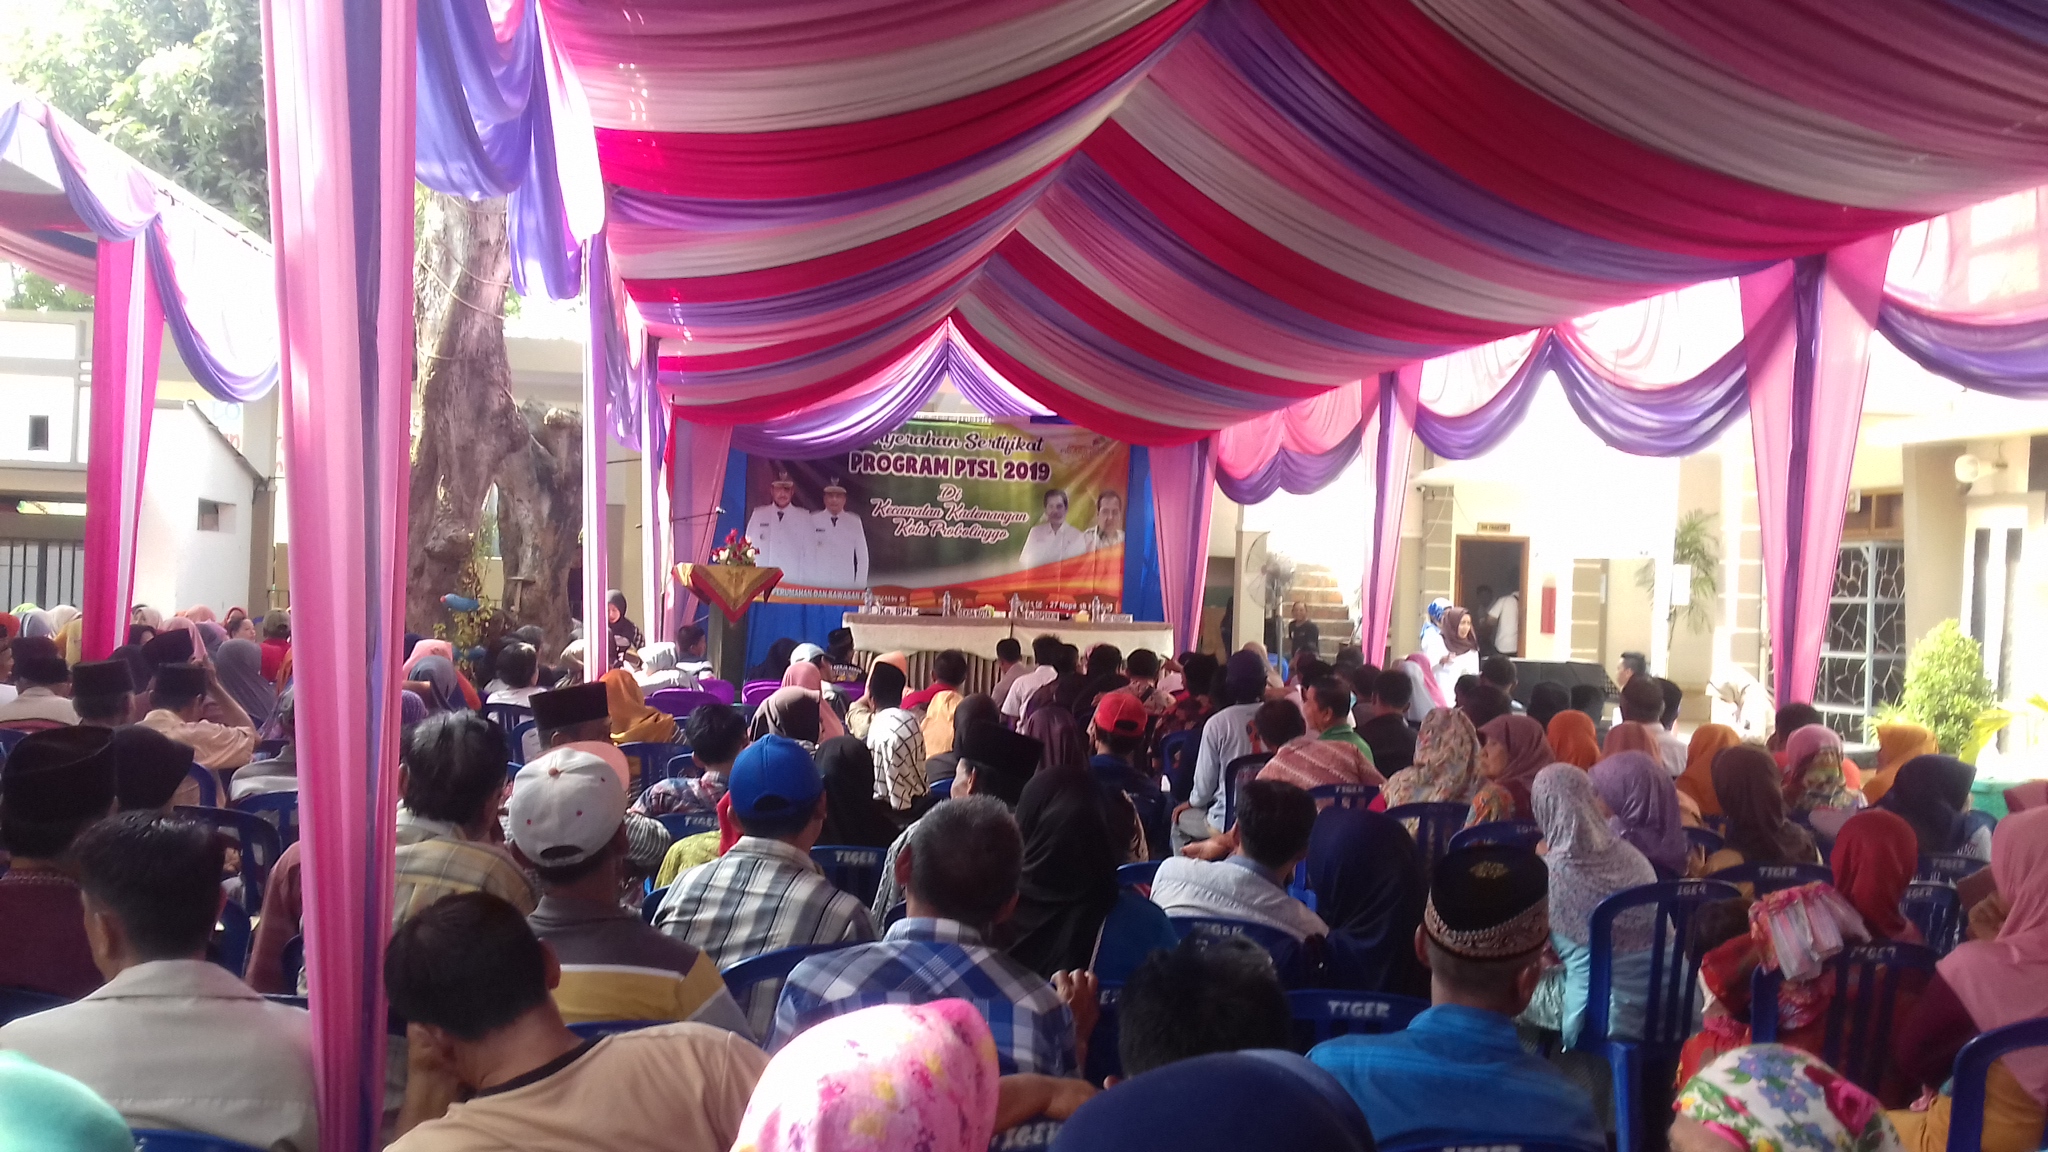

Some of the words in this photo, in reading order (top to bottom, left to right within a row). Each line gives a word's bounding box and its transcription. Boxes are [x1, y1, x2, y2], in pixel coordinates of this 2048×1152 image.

[851, 453, 949, 478] PROGRAM
[953, 456, 998, 479] PTSL
[1003, 461, 1051, 481] 2019
[937, 484, 962, 502] Di
[870, 498, 943, 519] Kecamatan
[944, 502, 1030, 526] Kademangan
[893, 518, 930, 537] Kota
[929, 520, 1009, 544] Probolinggo
[813, 589, 828, 598] DAN
[828, 590, 861, 600] KAWASAN
[895, 608, 912, 616] BPN
[835, 850, 878, 865] TIGER
[1759, 866, 1797, 878] TIGER
[1906, 886, 1933, 899] IGER
[1328, 1000, 1390, 1018] TIGER
